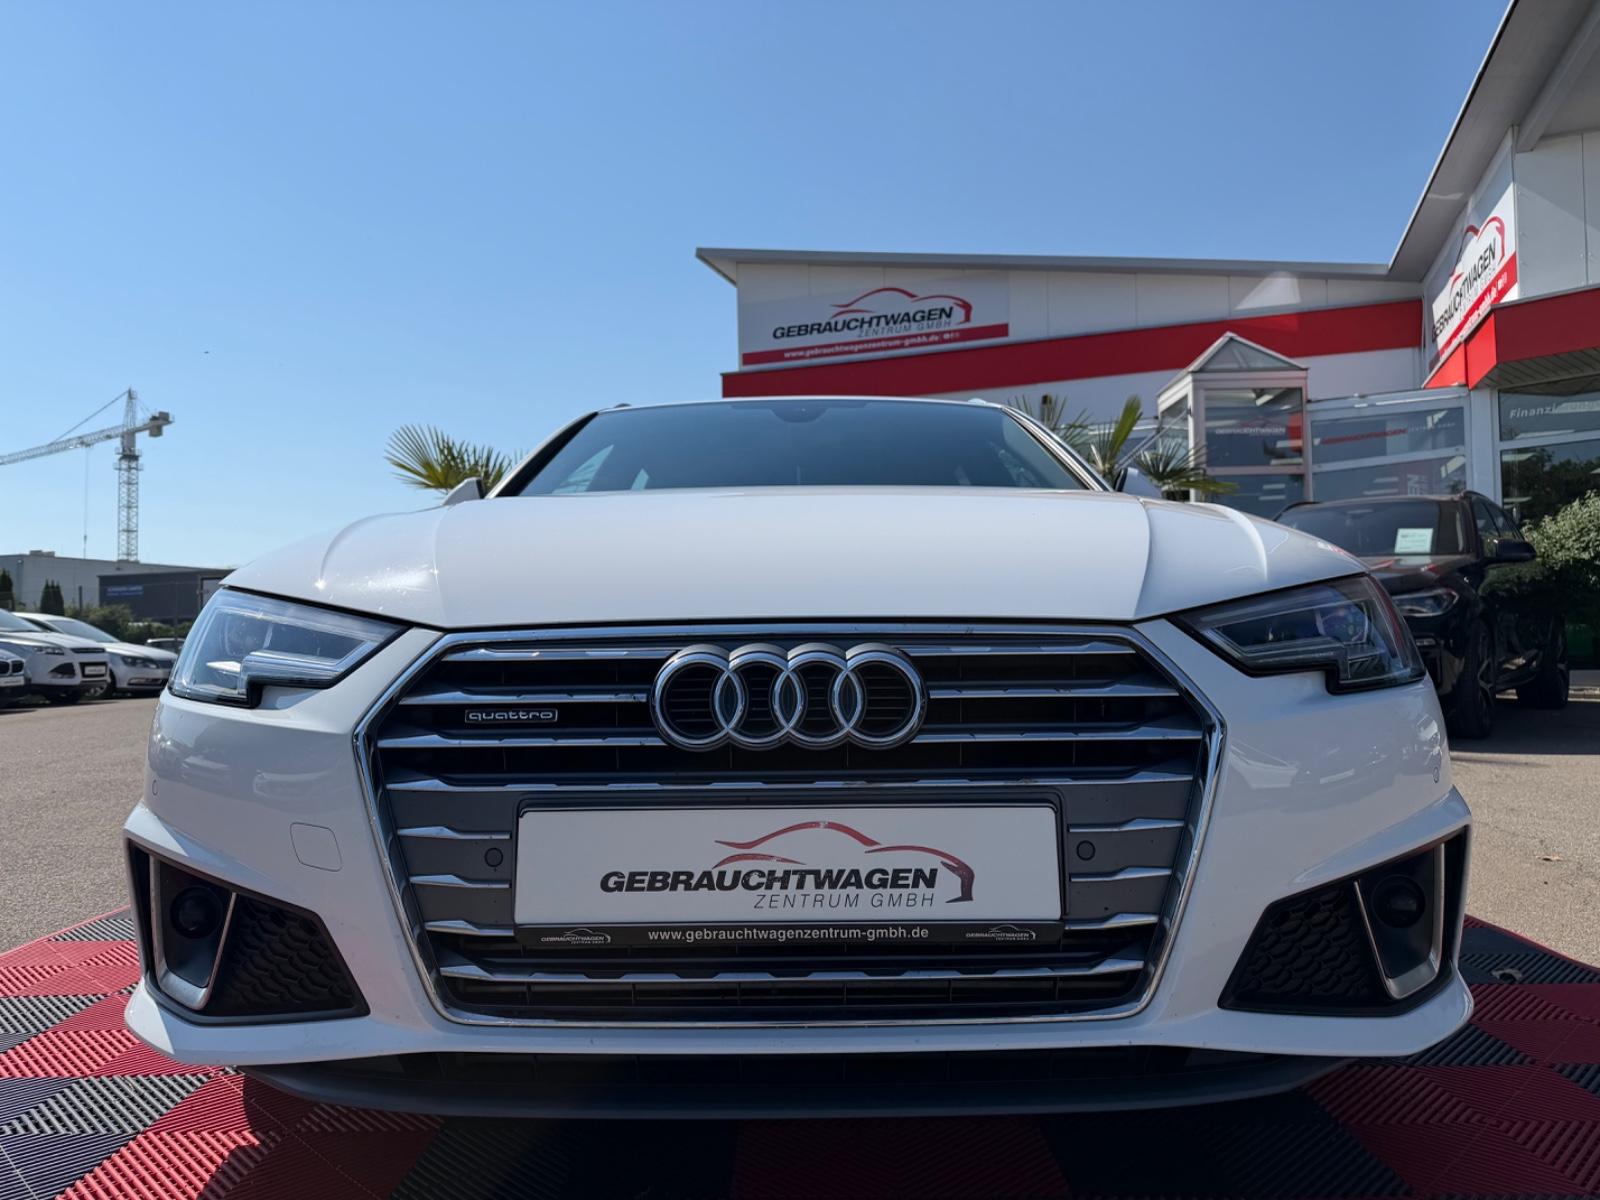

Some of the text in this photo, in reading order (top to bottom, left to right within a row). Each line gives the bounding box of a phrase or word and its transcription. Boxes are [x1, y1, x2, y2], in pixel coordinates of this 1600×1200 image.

[772, 306, 953, 340] GEBRAUCHTWAGEN
[857, 320, 951, 338] ZENTRUM GMBH
[468, 711, 553, 721] quattro
[600, 867, 938, 893] GEBRAUCHTWAGEN
[753, 892, 935, 909] ZENTRUM GMBH
[648, 926, 929, 944] www.gebrauchtwagenzentrum-gmbh.de
